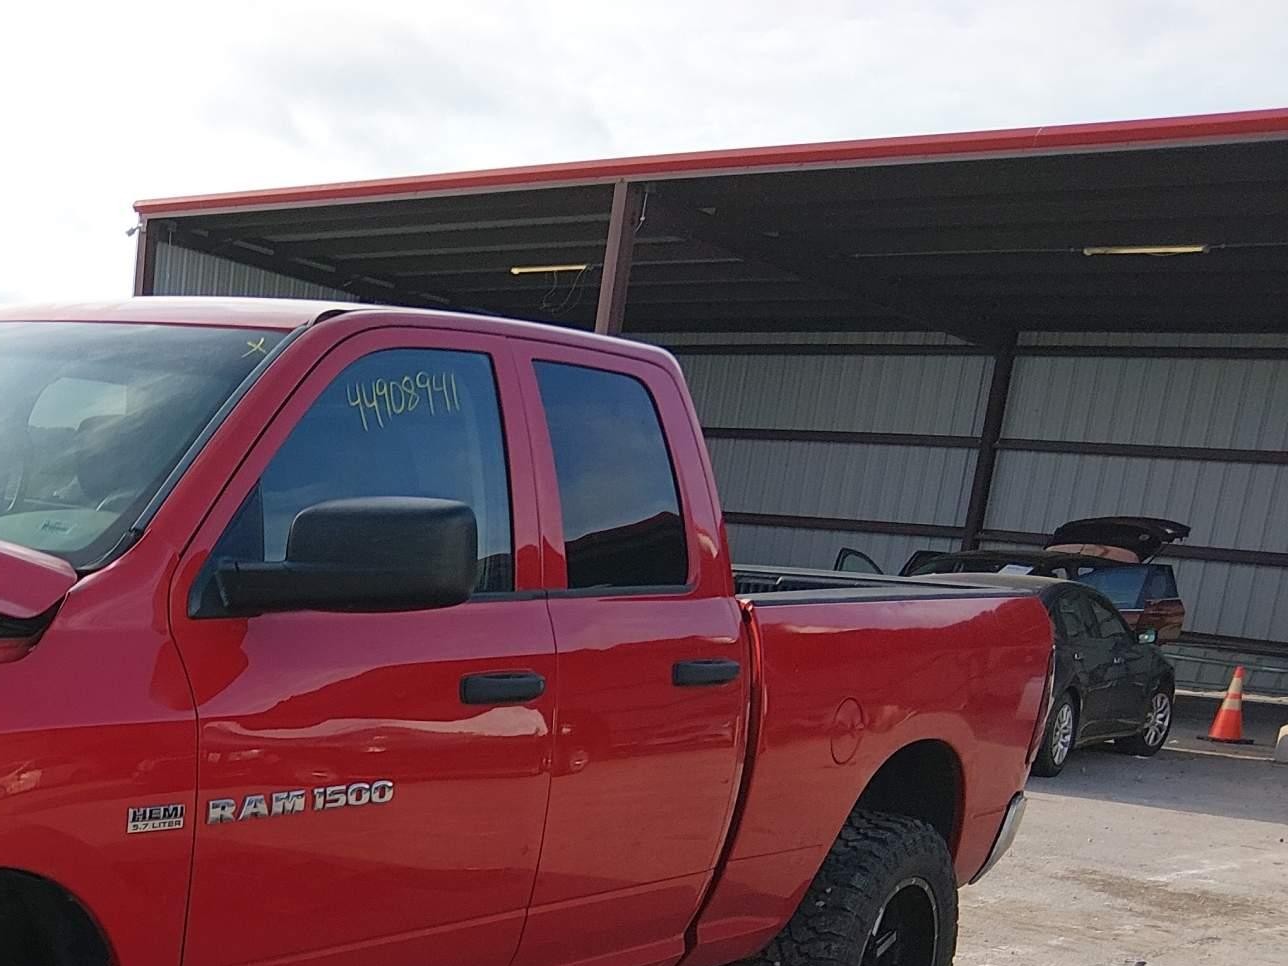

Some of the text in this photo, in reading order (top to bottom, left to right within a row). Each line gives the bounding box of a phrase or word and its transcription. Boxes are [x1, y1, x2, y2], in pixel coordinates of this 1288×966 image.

[346, 370, 461, 431] 44908941
[131, 805, 184, 823] HEMI
[206, 780, 393, 825] RAM 1500
[152, 820, 181, 829] LITER
